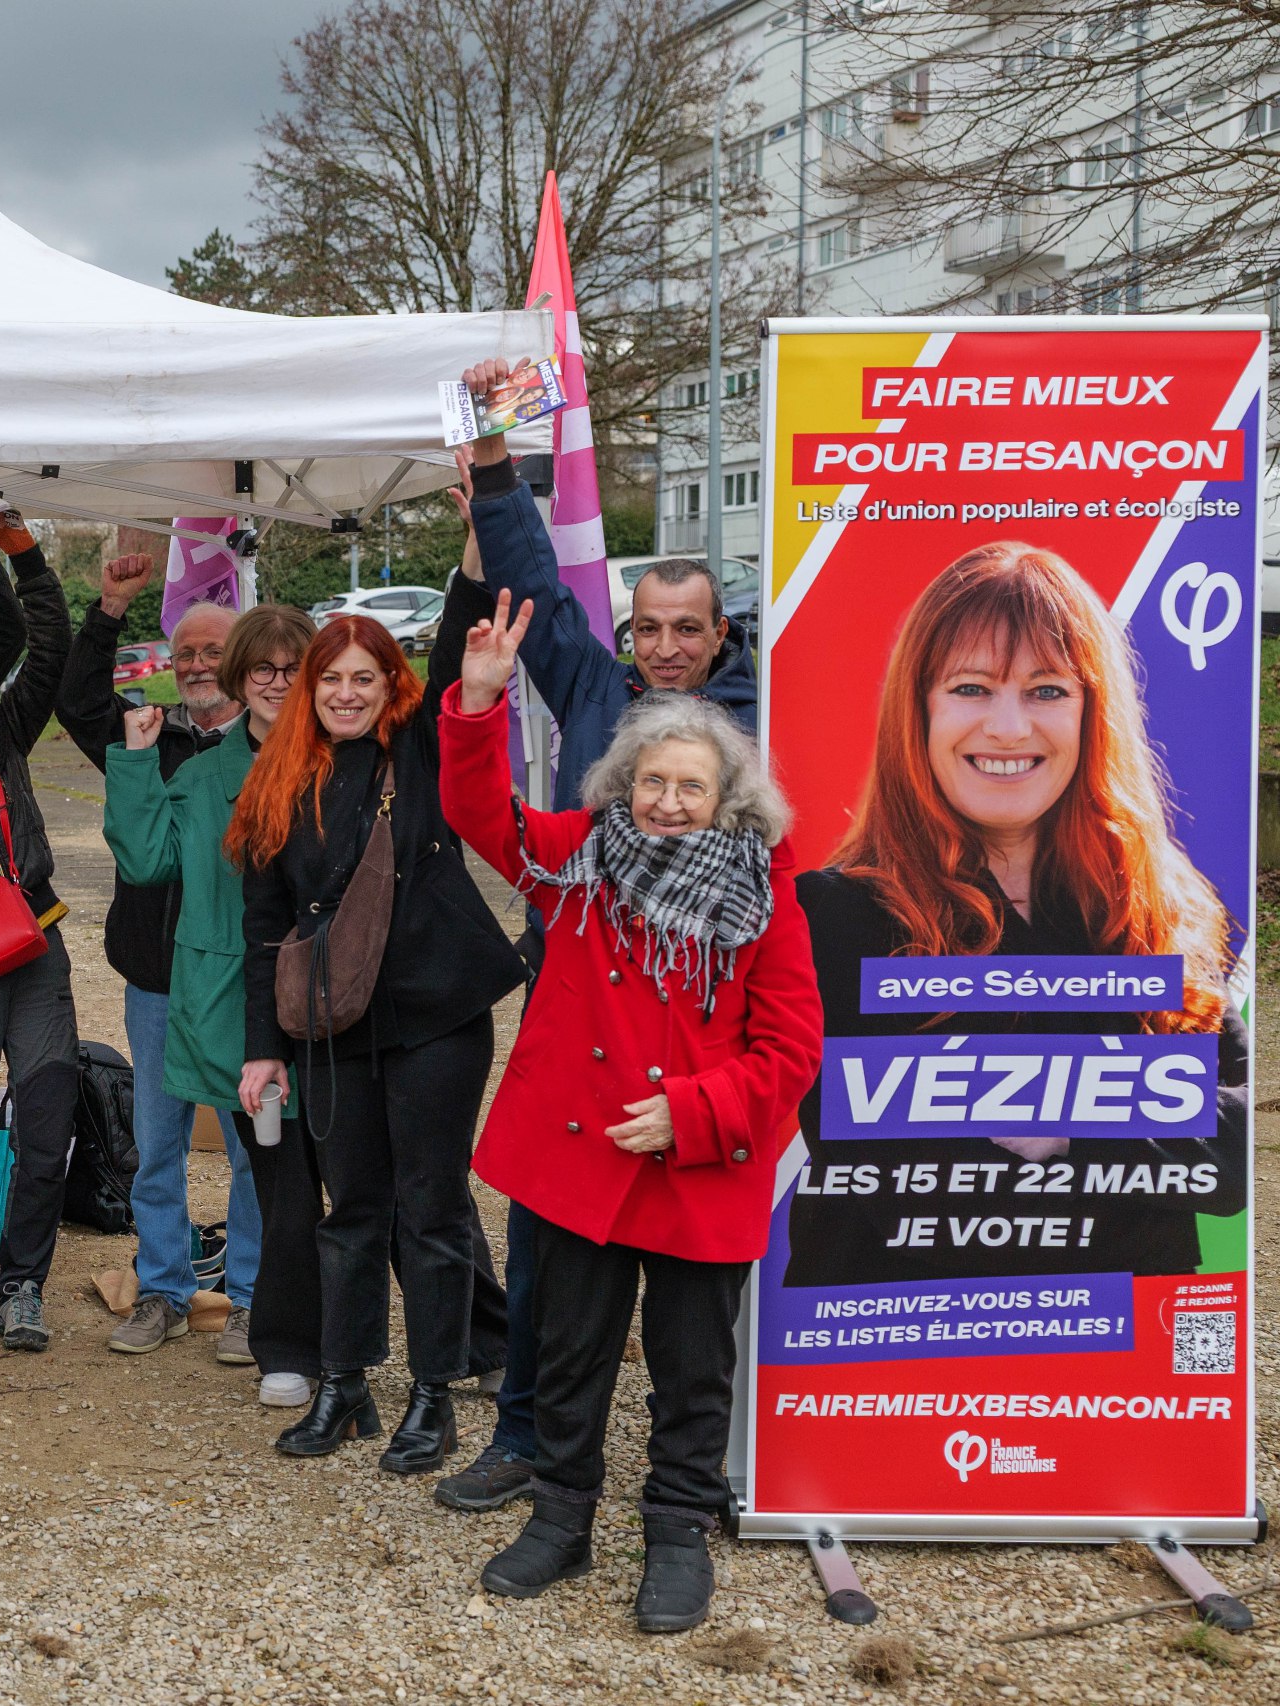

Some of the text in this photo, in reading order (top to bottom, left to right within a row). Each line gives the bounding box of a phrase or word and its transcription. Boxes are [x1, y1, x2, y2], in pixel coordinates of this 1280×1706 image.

[538, 360, 562, 407] MEETING
[871, 375, 1174, 407] FAIRE MIEUX
[457, 383, 476, 440] BESANÇON
[813, 440, 1228, 479] POUR BESANÇON
[797, 497, 1241, 523] Liste d’union populaire et écologiste
[878, 970, 1166, 998] avec Séverine
[841, 1036, 1207, 1124] VÉZIÈS
[796, 1163, 1219, 1195] LES 15 ET 22 MARS
[886, 1216, 1095, 1247] JE VOTE !
[815, 1289, 1091, 1319] INSCRIVEZ-VOUS SUR
[1173, 1298, 1187, 1307] JE
[1188, 1296, 1232, 1306] REJOINS
[1175, 1283, 1234, 1295] JE SCANNE
[784, 1316, 1125, 1349] LES LISTES ÉLECTORALES !
[775, 1393, 1232, 1420] FAIREMIEUXBESANCON.FR
[991, 1438, 1001, 1447] LA
[991, 1446, 1037, 1462] FRANCE
